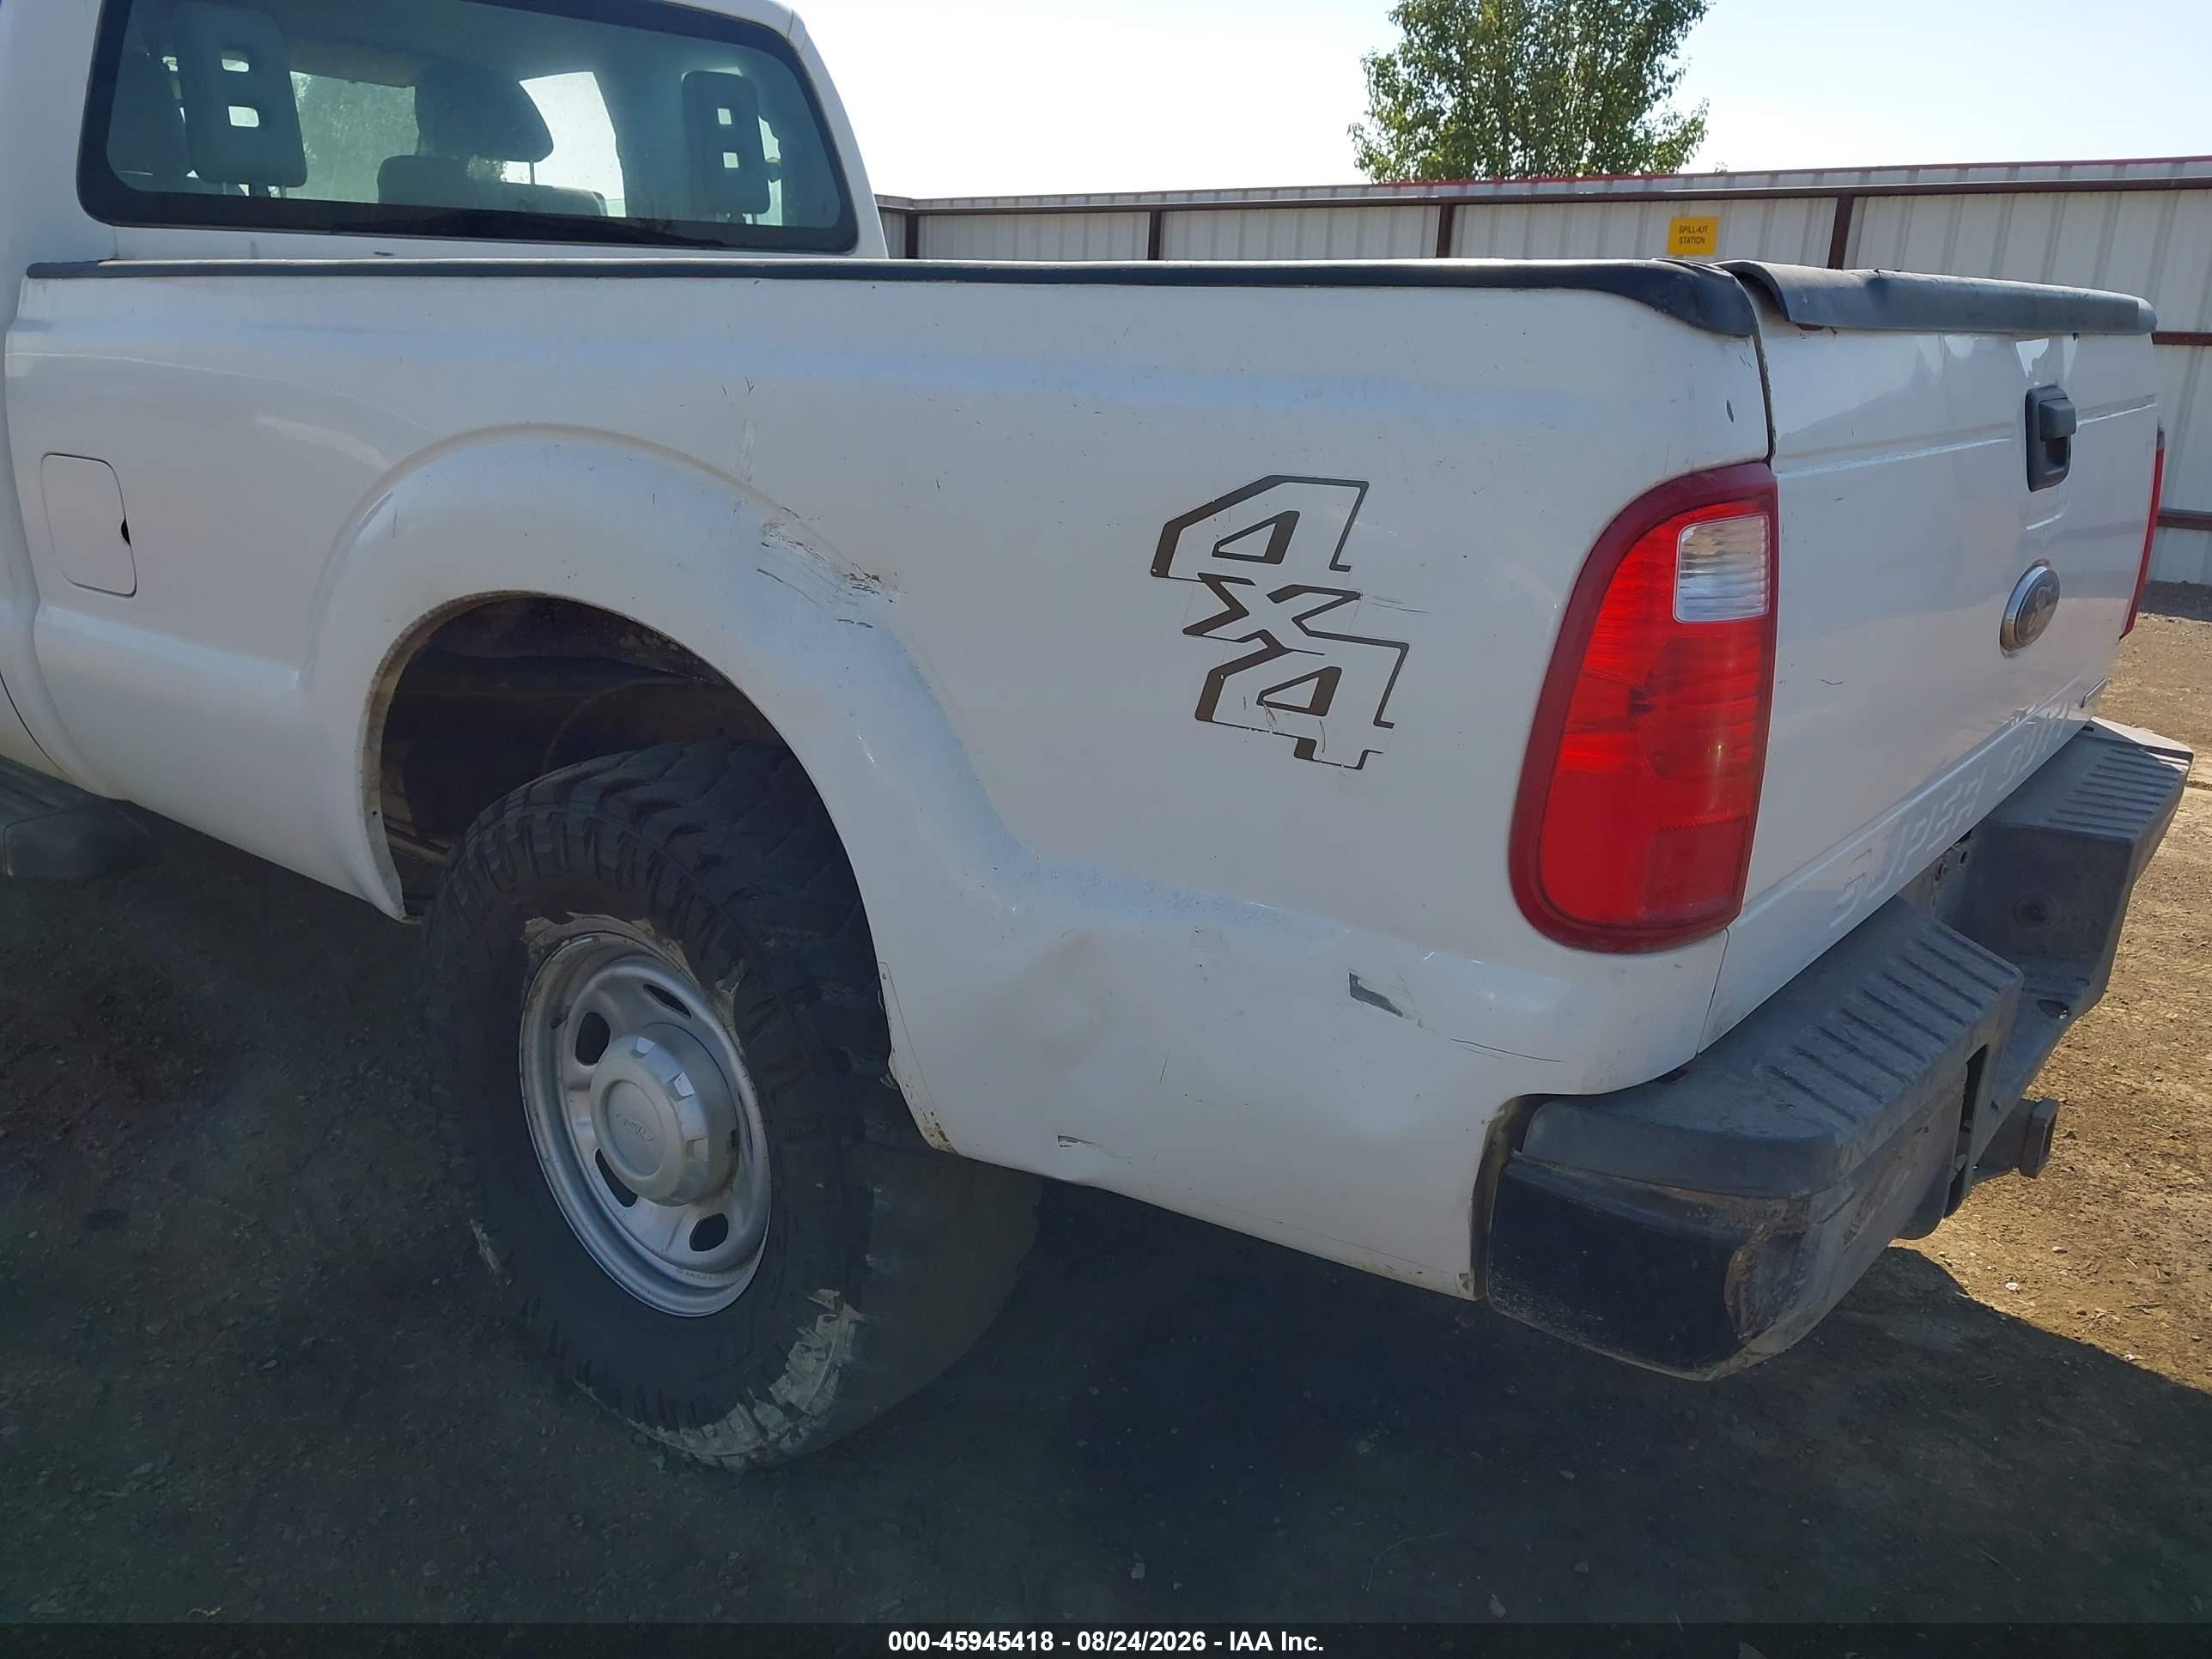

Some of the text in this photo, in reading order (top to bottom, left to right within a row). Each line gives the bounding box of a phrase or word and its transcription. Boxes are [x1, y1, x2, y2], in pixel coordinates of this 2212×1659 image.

[1679, 225, 1709, 234] SPILL-KIT
[1679, 236, 1705, 245] STATION
[1828, 763, 1989, 928] SUPER
